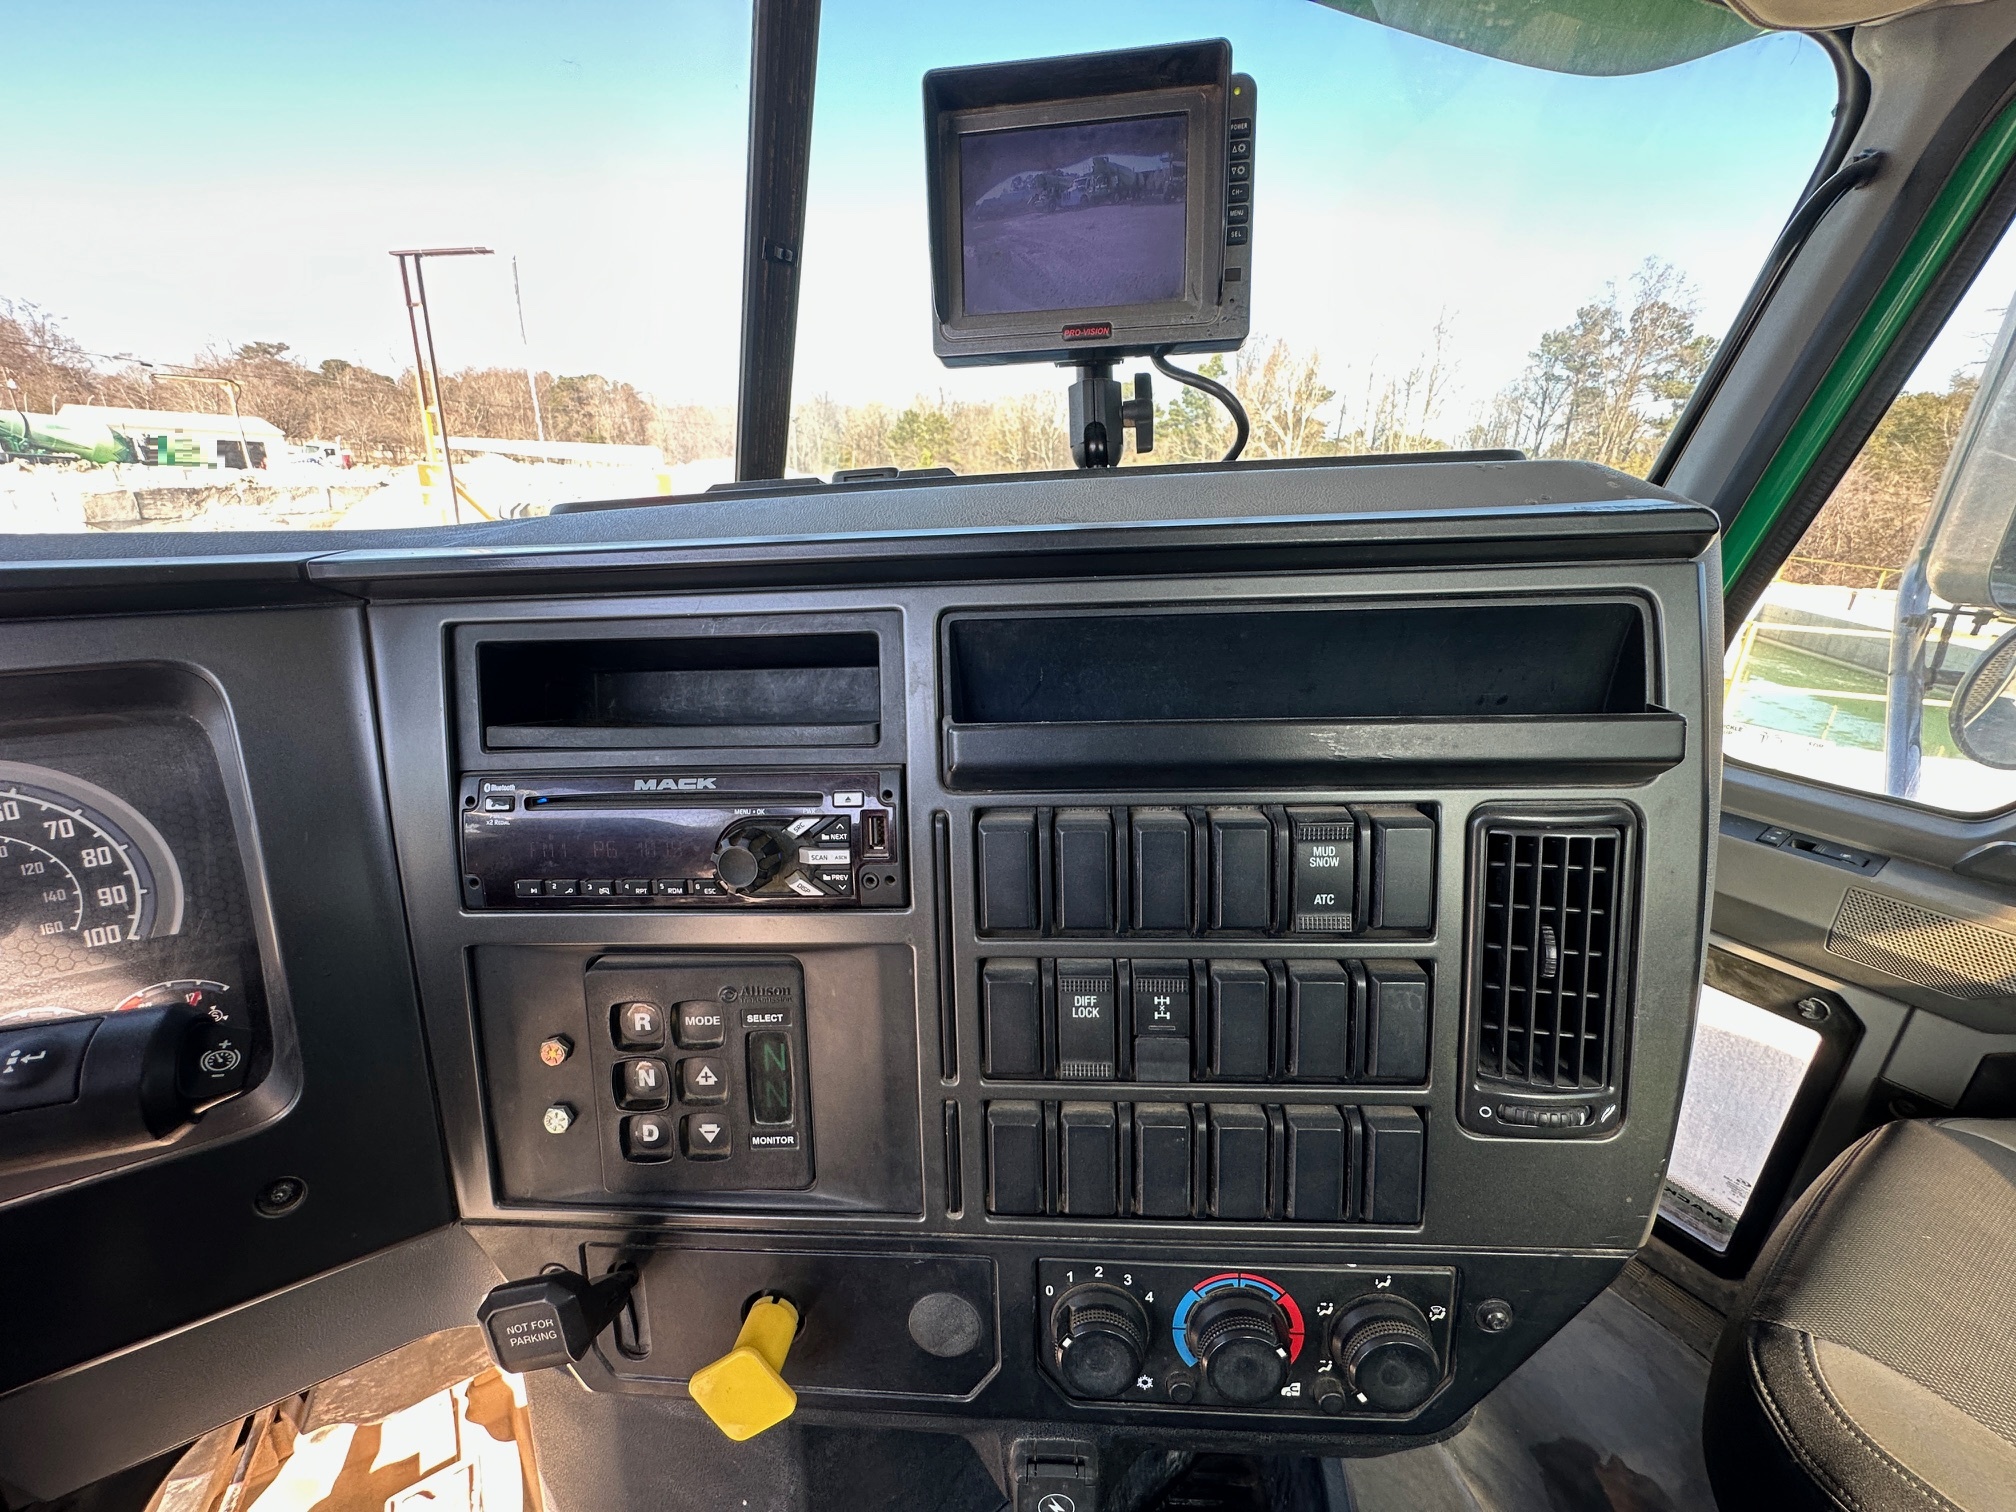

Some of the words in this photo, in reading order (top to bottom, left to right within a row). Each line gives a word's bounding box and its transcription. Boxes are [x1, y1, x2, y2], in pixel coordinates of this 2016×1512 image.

[1230, 123, 1248, 131] POWER
[1231, 230, 1242, 238] SEL
[1064, 326, 1110, 337] PRO-VISION
[490, 783, 516, 791] Bluetooth
[634, 777, 717, 791] MACK
[42, 818, 75, 839] 70
[793, 822, 805, 833] SRC
[80, 846, 112, 868] 80
[1313, 846, 1336, 856] MUD
[1309, 856, 1340, 867] SNOW
[20, 861, 45, 876] 120
[796, 882, 811, 893] DISP
[42, 889, 67, 903] 140
[97, 885, 128, 907] 90
[1313, 894, 1335, 905] ATC
[40, 921, 64, 936] 160
[83, 924, 121, 948] 100
[740, 985, 791, 996] Allison
[1074, 996, 1097, 1007] DIFF
[746, 1014, 784, 1023] SELECT
[1072, 1007, 1100, 1018] LOCK
[634, 1013, 651, 1031] R
[685, 1016, 721, 1026] MODE
[763, 1043, 787, 1071] N
[638, 1069, 656, 1087] N
[765, 1081, 788, 1108] N
[642, 1124, 659, 1142] D
[752, 1136, 795, 1145] MONITOR
[1066, 1270, 1074, 1282] 1
[1094, 1266, 1103, 1278] 2
[1123, 1274, 1133, 1286] 3
[1045, 1284, 1054, 1297] 0
[1144, 1291, 1154, 1303] 4
[506, 1322, 528, 1335] NOT
[531, 1319, 554, 1330] FOR
[510, 1330, 558, 1347] PARKING
